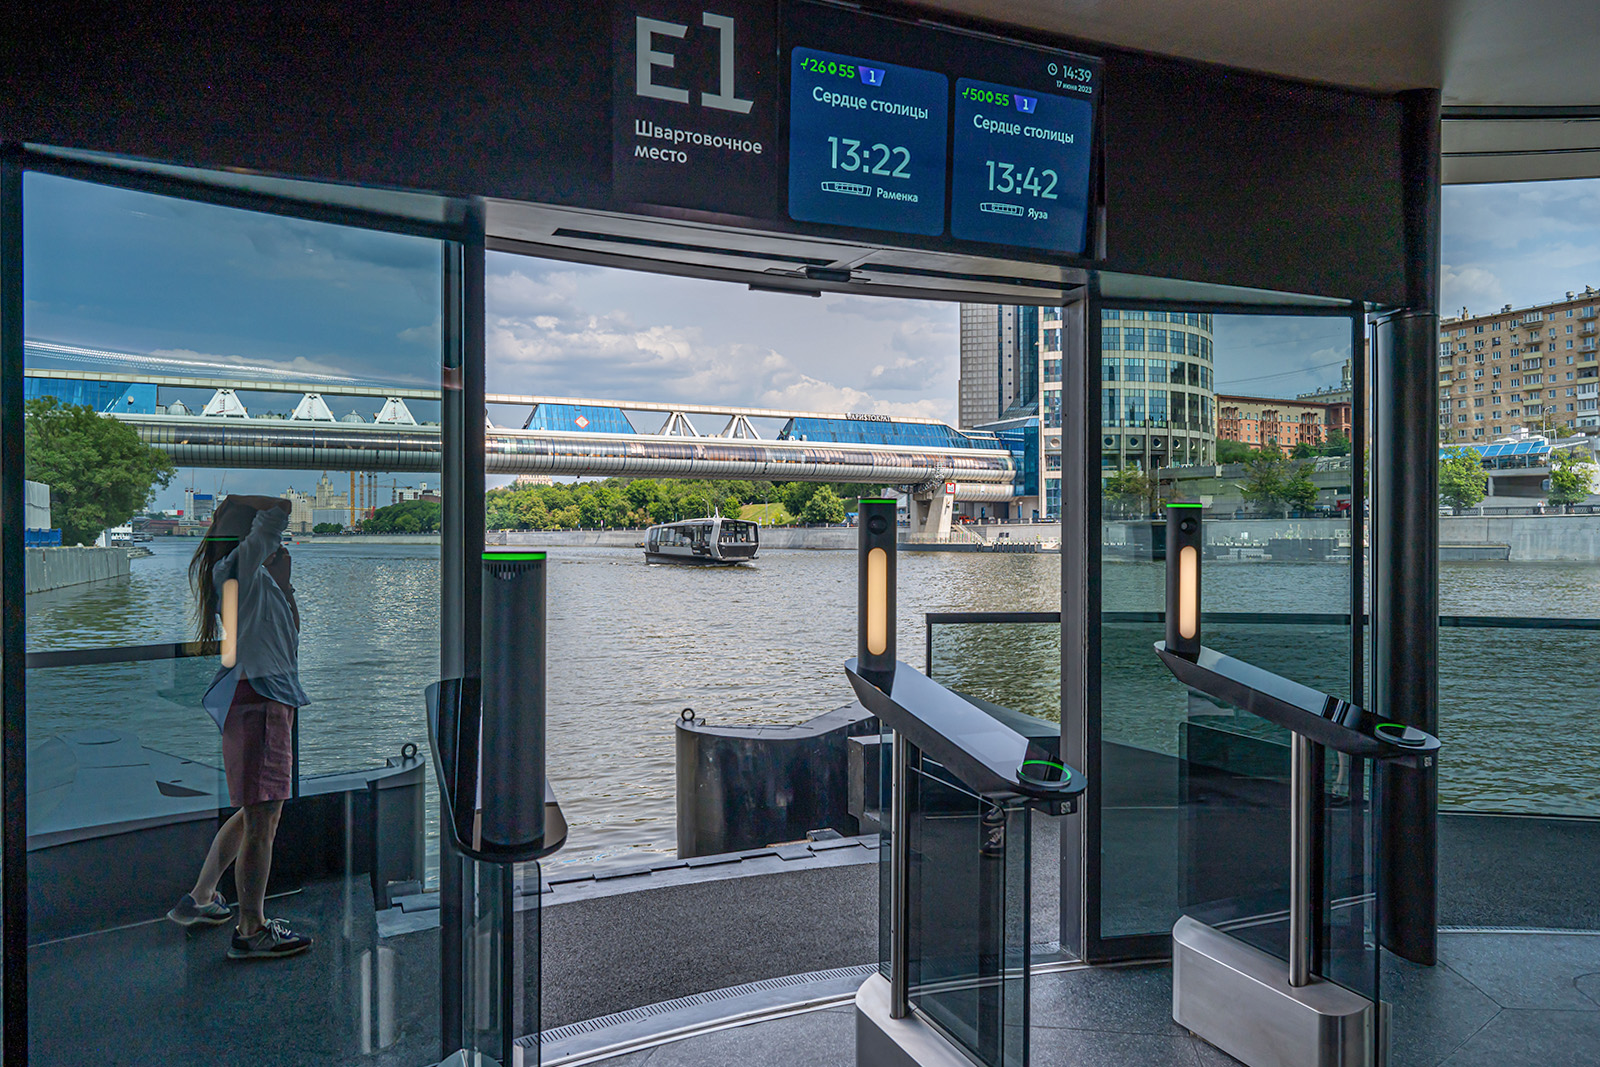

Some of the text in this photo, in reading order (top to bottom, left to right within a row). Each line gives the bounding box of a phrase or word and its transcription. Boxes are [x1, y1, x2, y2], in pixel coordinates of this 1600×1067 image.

[636, 11, 754, 114] E1
[869, 70, 876, 83] 1
[1062, 65, 1092, 82] 14:39
[1078, 84, 1092, 94] 2023
[812, 86, 929, 120] Сердце столицы
[1023, 98, 1029, 110] 1
[635, 119, 763, 154] Швартовочное
[973, 114, 1074, 145] Сердце столицы
[634, 145, 688, 163] место
[827, 136, 911, 179] 13:22
[985, 160, 1059, 200] 13:42
[876, 187, 919, 203] Раменка
[1027, 207, 1048, 220] Яуза
